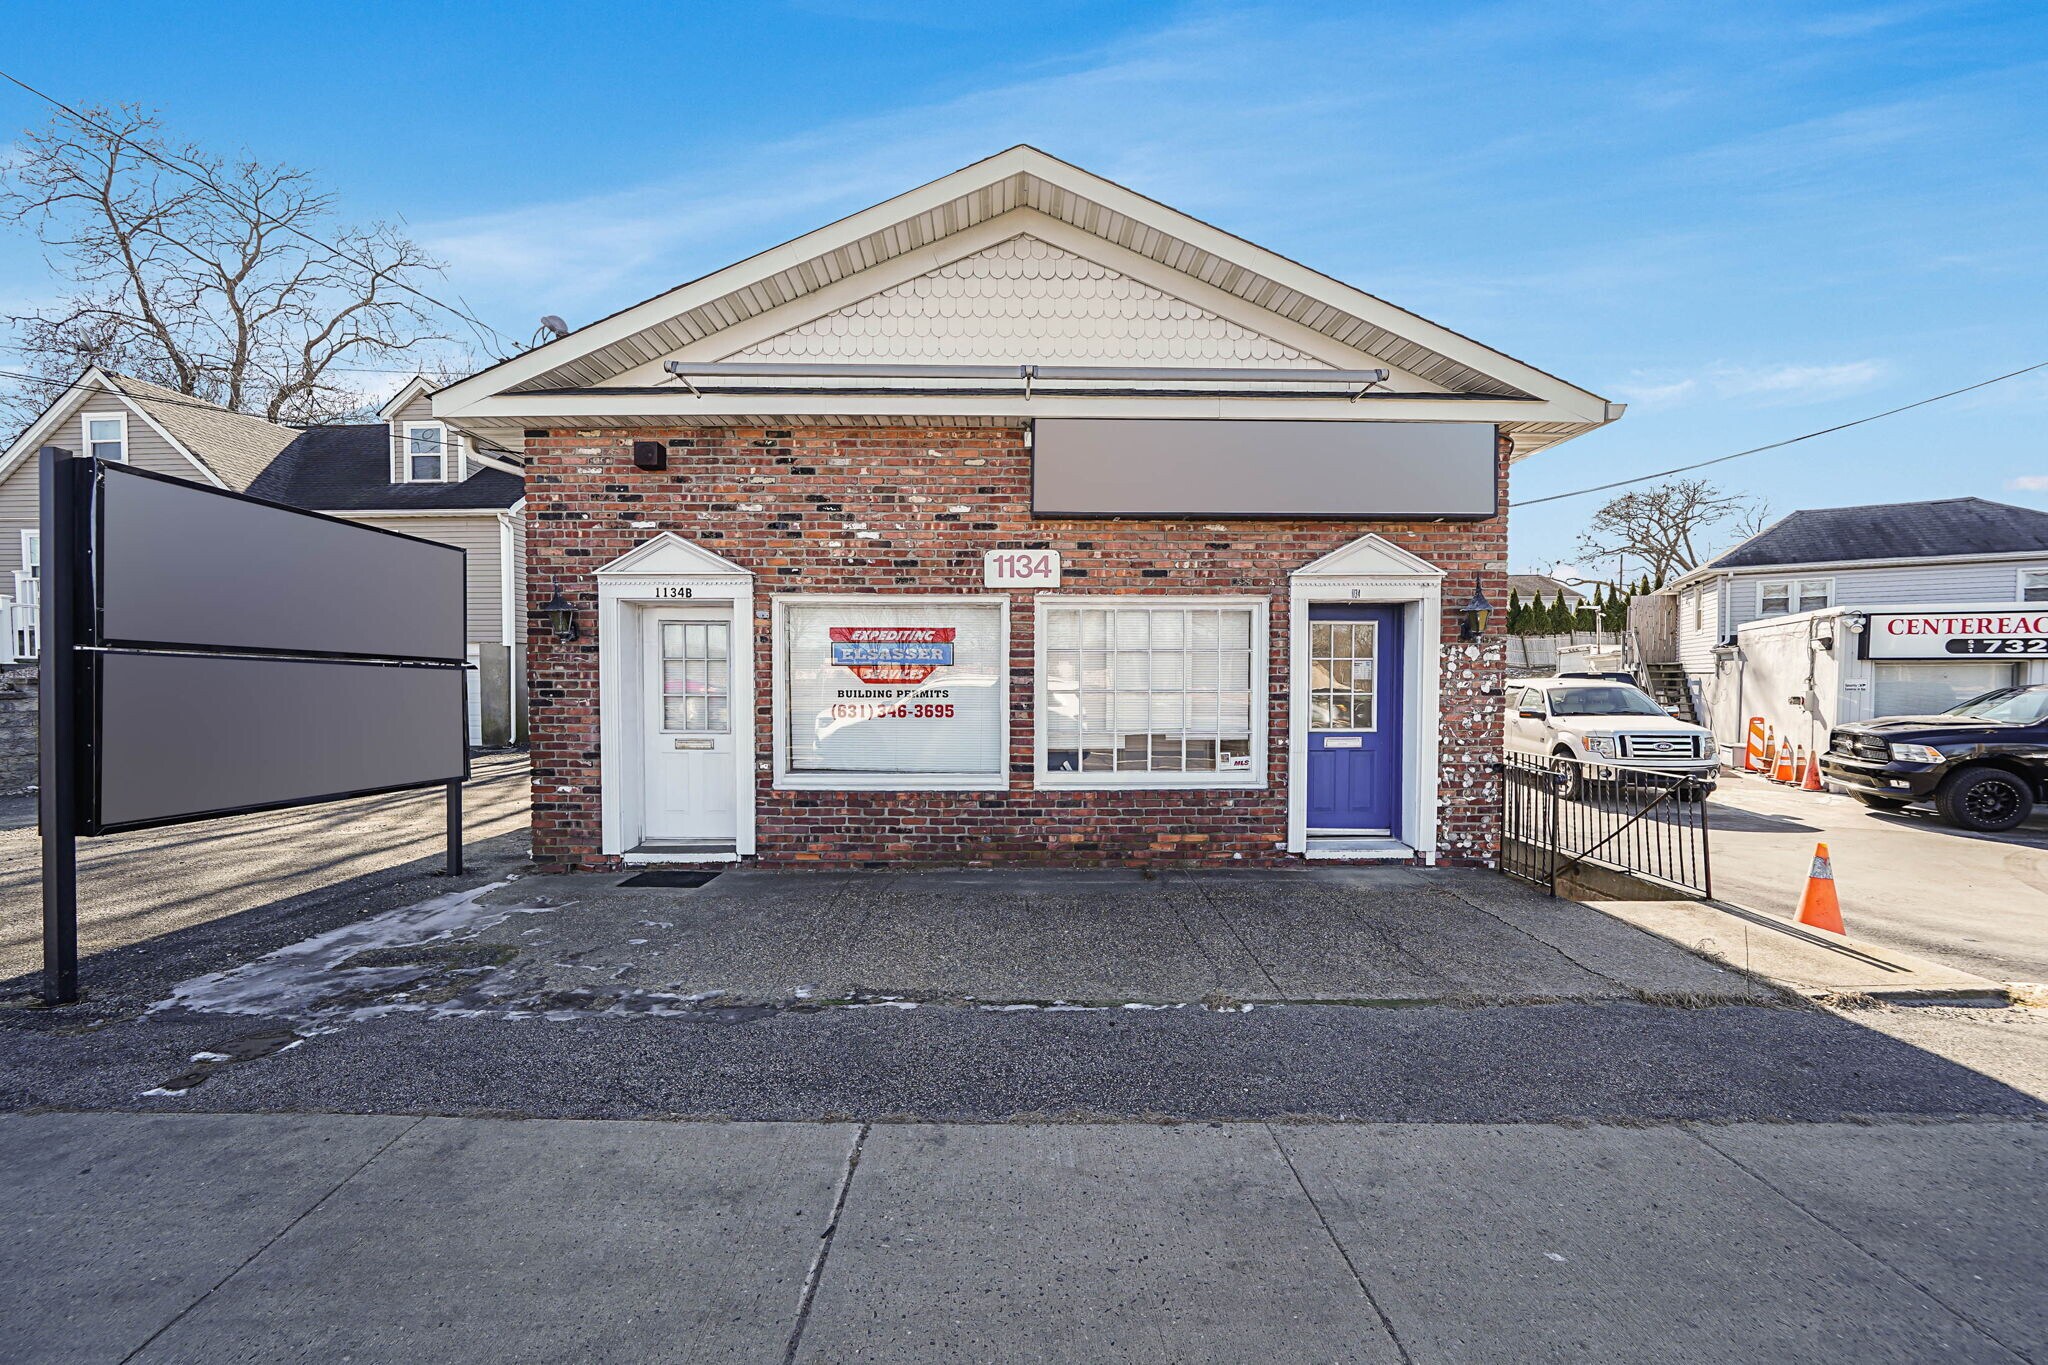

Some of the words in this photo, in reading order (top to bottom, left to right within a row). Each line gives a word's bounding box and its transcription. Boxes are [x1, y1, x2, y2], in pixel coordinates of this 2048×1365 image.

[993, 555, 1052, 578] 1134
[656, 587, 692, 598] 1134B
[1887, 617, 2048, 635] CENTEREAC
[851, 631, 936, 641] EXPEDITING
[1983, 640, 2048, 653] 732
[842, 648, 944, 660] ELSASSER
[837, 690, 892, 698] BUILDING
[831, 704, 873, 720] (631)
[877, 704, 954, 718] 346-3695
